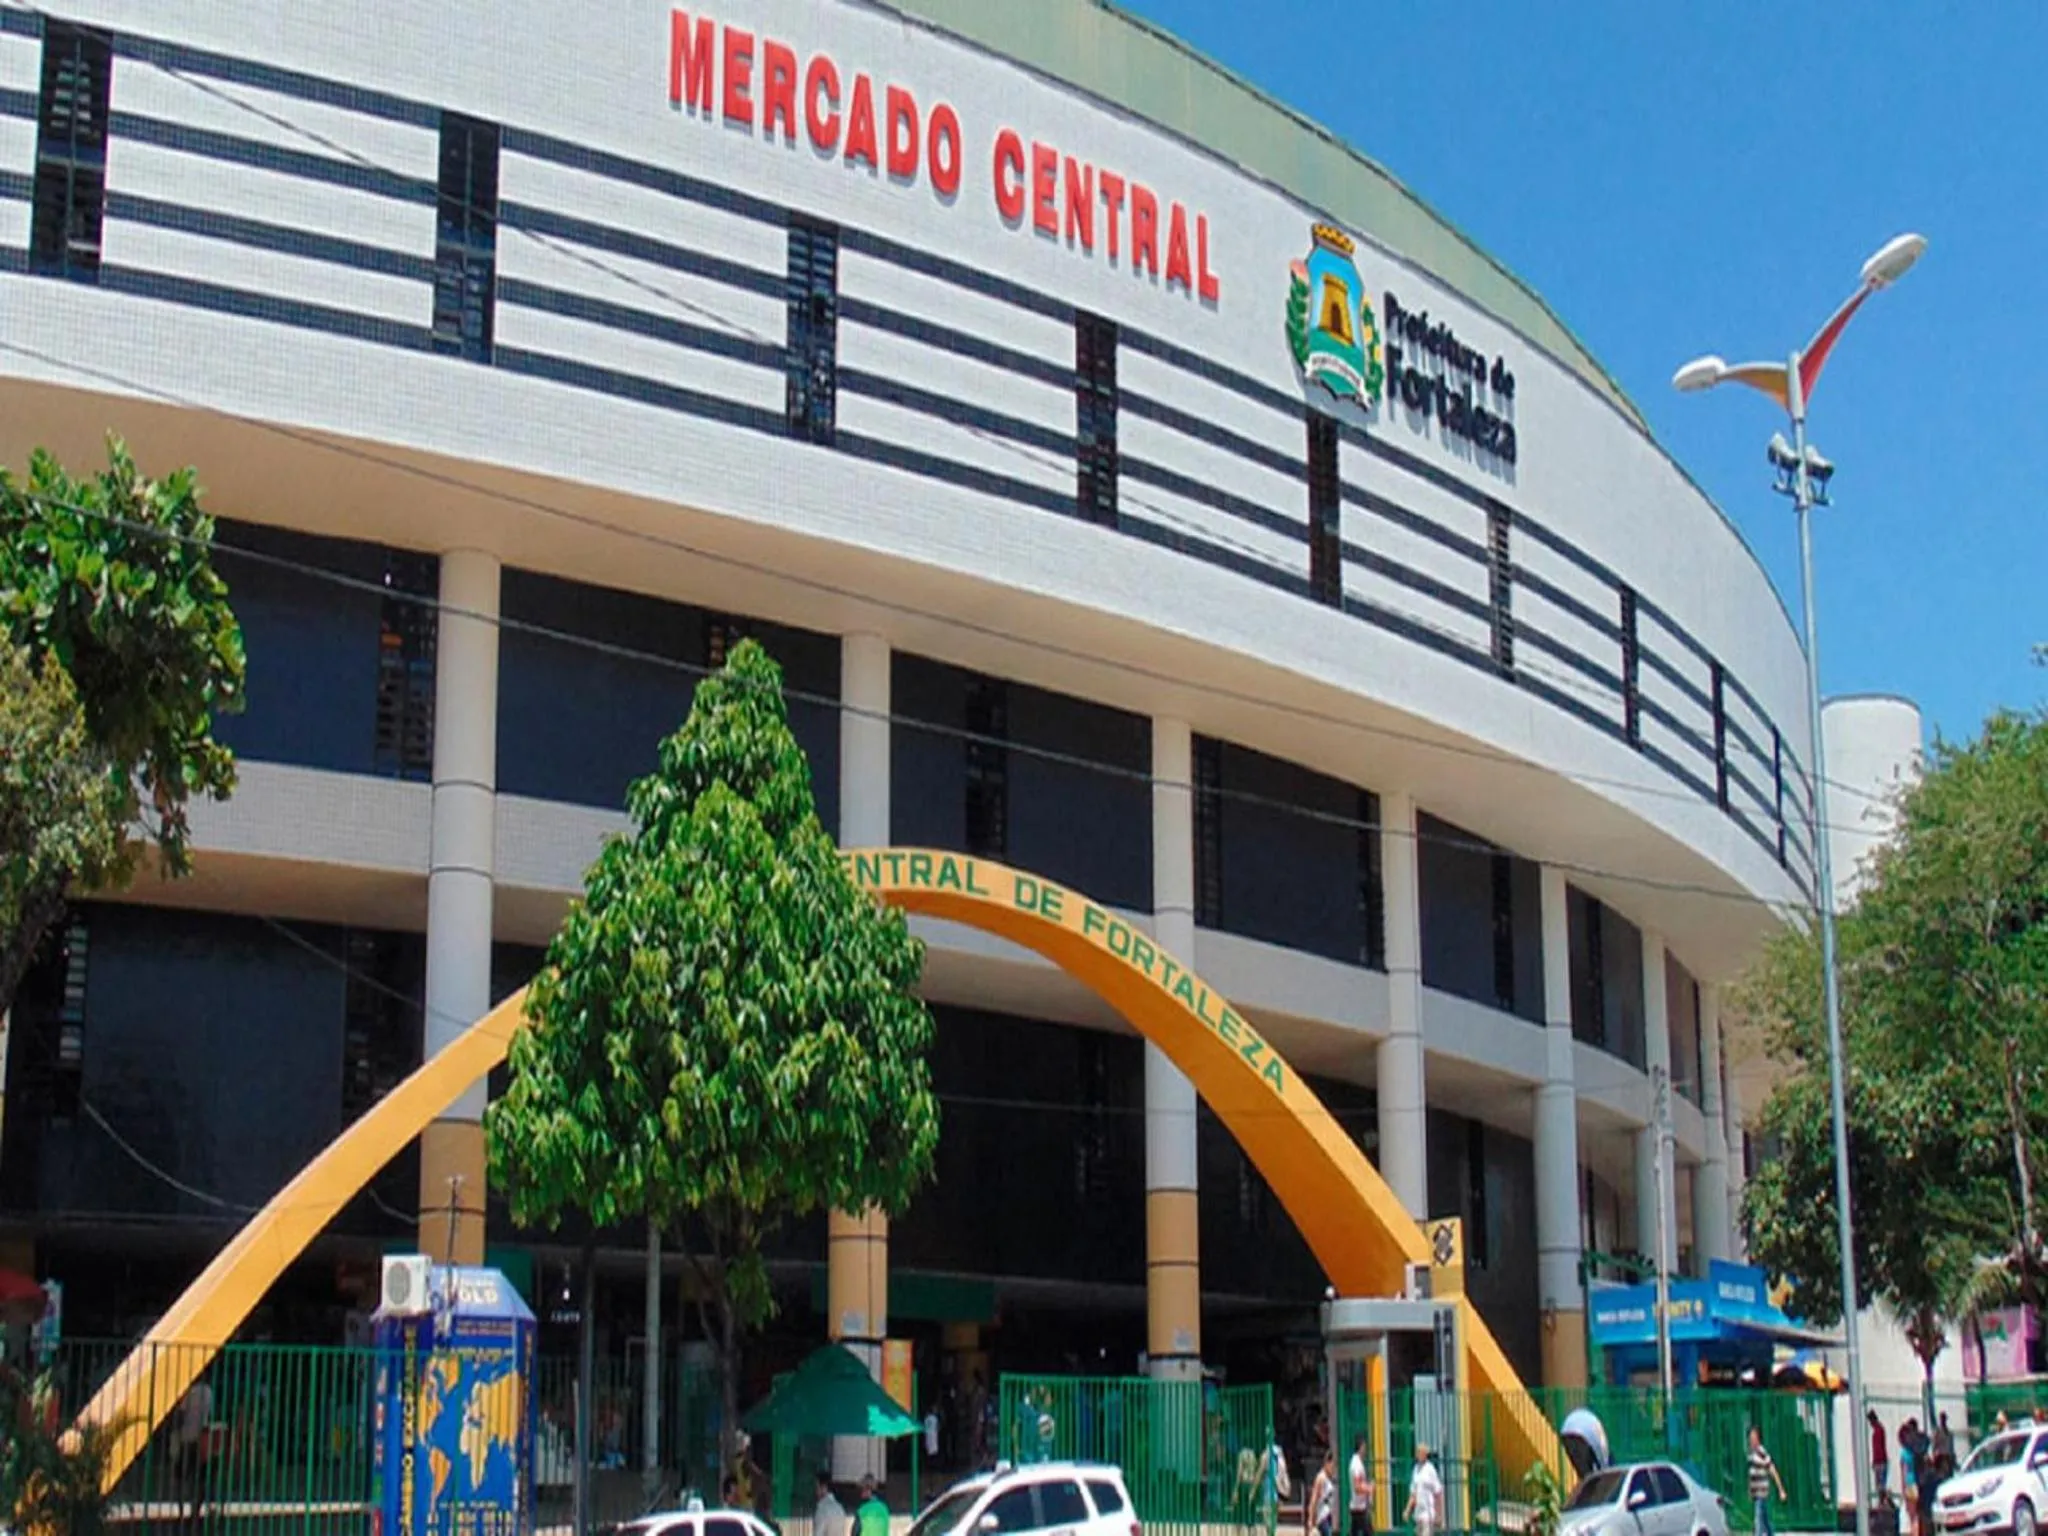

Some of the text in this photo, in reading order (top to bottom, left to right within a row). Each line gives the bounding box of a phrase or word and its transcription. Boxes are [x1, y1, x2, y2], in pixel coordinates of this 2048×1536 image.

[670, 9, 1219, 300] MERCADO CENTRAL
[1385, 343, 1515, 466] Fortaleza
[1015, 876, 1064, 921] DE
[1083, 905, 1286, 1092] FORTALEZA
